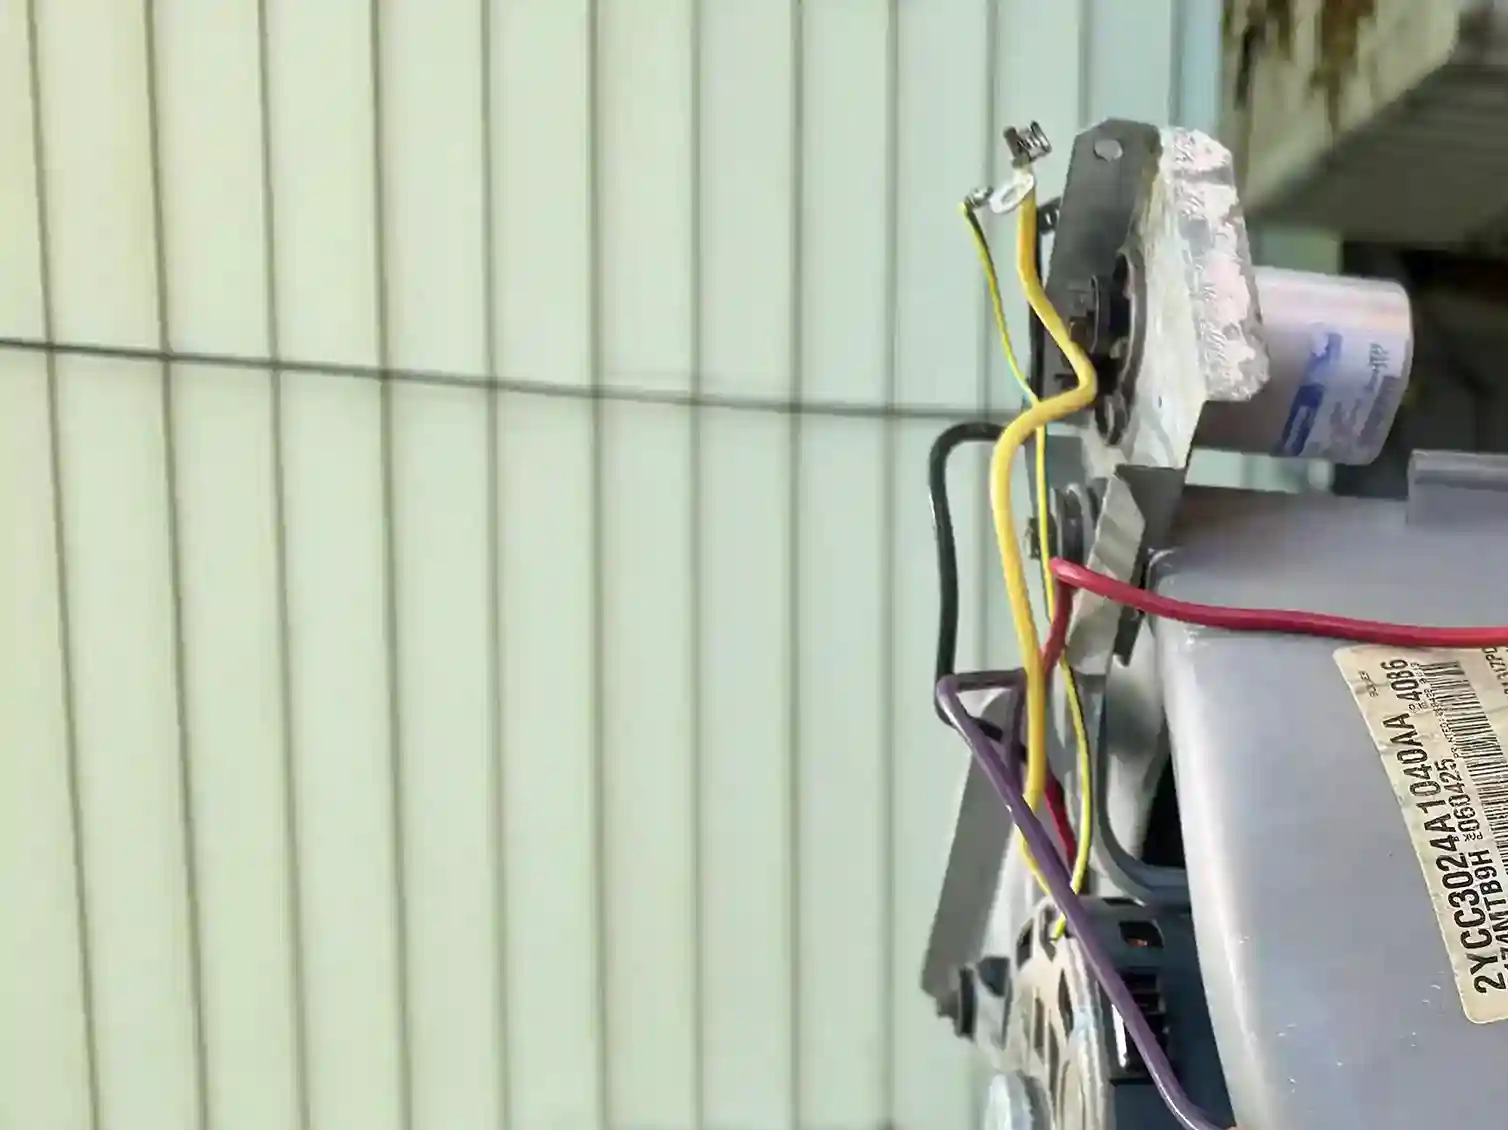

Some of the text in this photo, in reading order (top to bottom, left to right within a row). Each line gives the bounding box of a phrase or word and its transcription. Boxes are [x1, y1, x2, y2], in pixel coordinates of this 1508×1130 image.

[1380, 660, 1422, 701] 4086
[1434, 759, 1480, 832] 060425
[1383, 712, 1506, 993] 2YCC3024A1040AA
